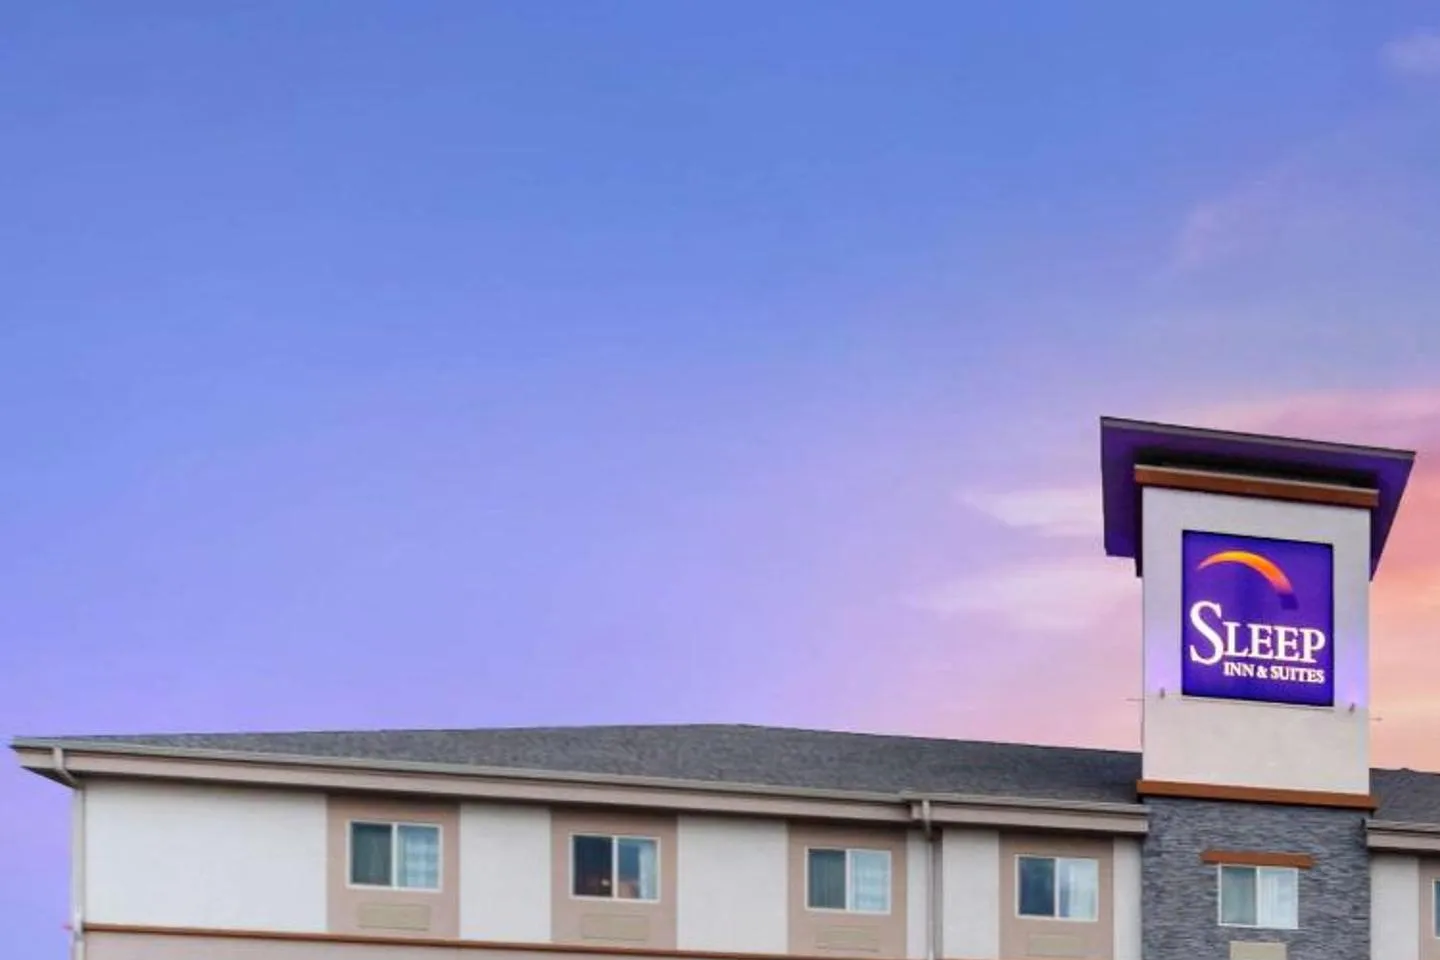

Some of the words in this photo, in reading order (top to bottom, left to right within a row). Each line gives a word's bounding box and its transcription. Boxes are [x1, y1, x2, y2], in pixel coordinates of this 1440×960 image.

[1190, 601, 1325, 664] SLEEP
[1224, 662, 1255, 677] INN
[1257, 665, 1268, 679] &
[1270, 666, 1324, 683] SUITES
